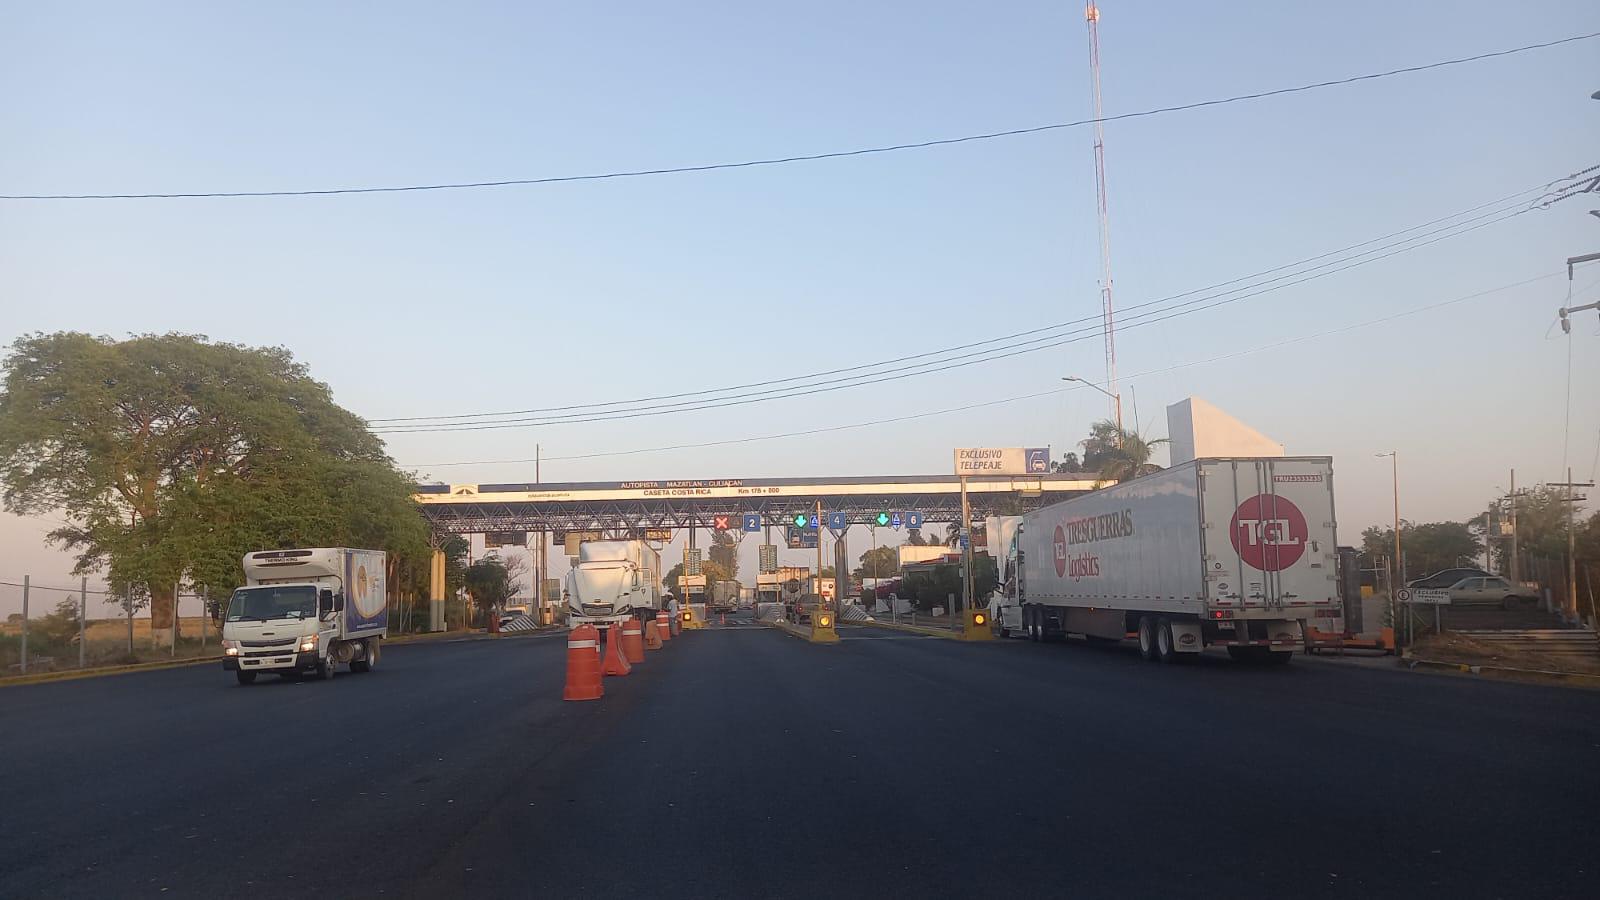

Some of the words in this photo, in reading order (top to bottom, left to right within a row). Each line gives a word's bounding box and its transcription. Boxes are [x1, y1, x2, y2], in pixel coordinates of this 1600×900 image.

[960, 450, 1002, 458] EXCLUSIVO
[960, 461, 1002, 469] TELEPEAJE
[672, 488, 694, 496] COSTA
[749, 519, 755, 528] 2
[834, 516, 840, 525] 4
[910, 515, 917, 524] 6
[1066, 508, 1133, 545] TRESGUERRAS
[1239, 519, 1299, 546] TGL
[1068, 552, 1100, 582] Logistics
